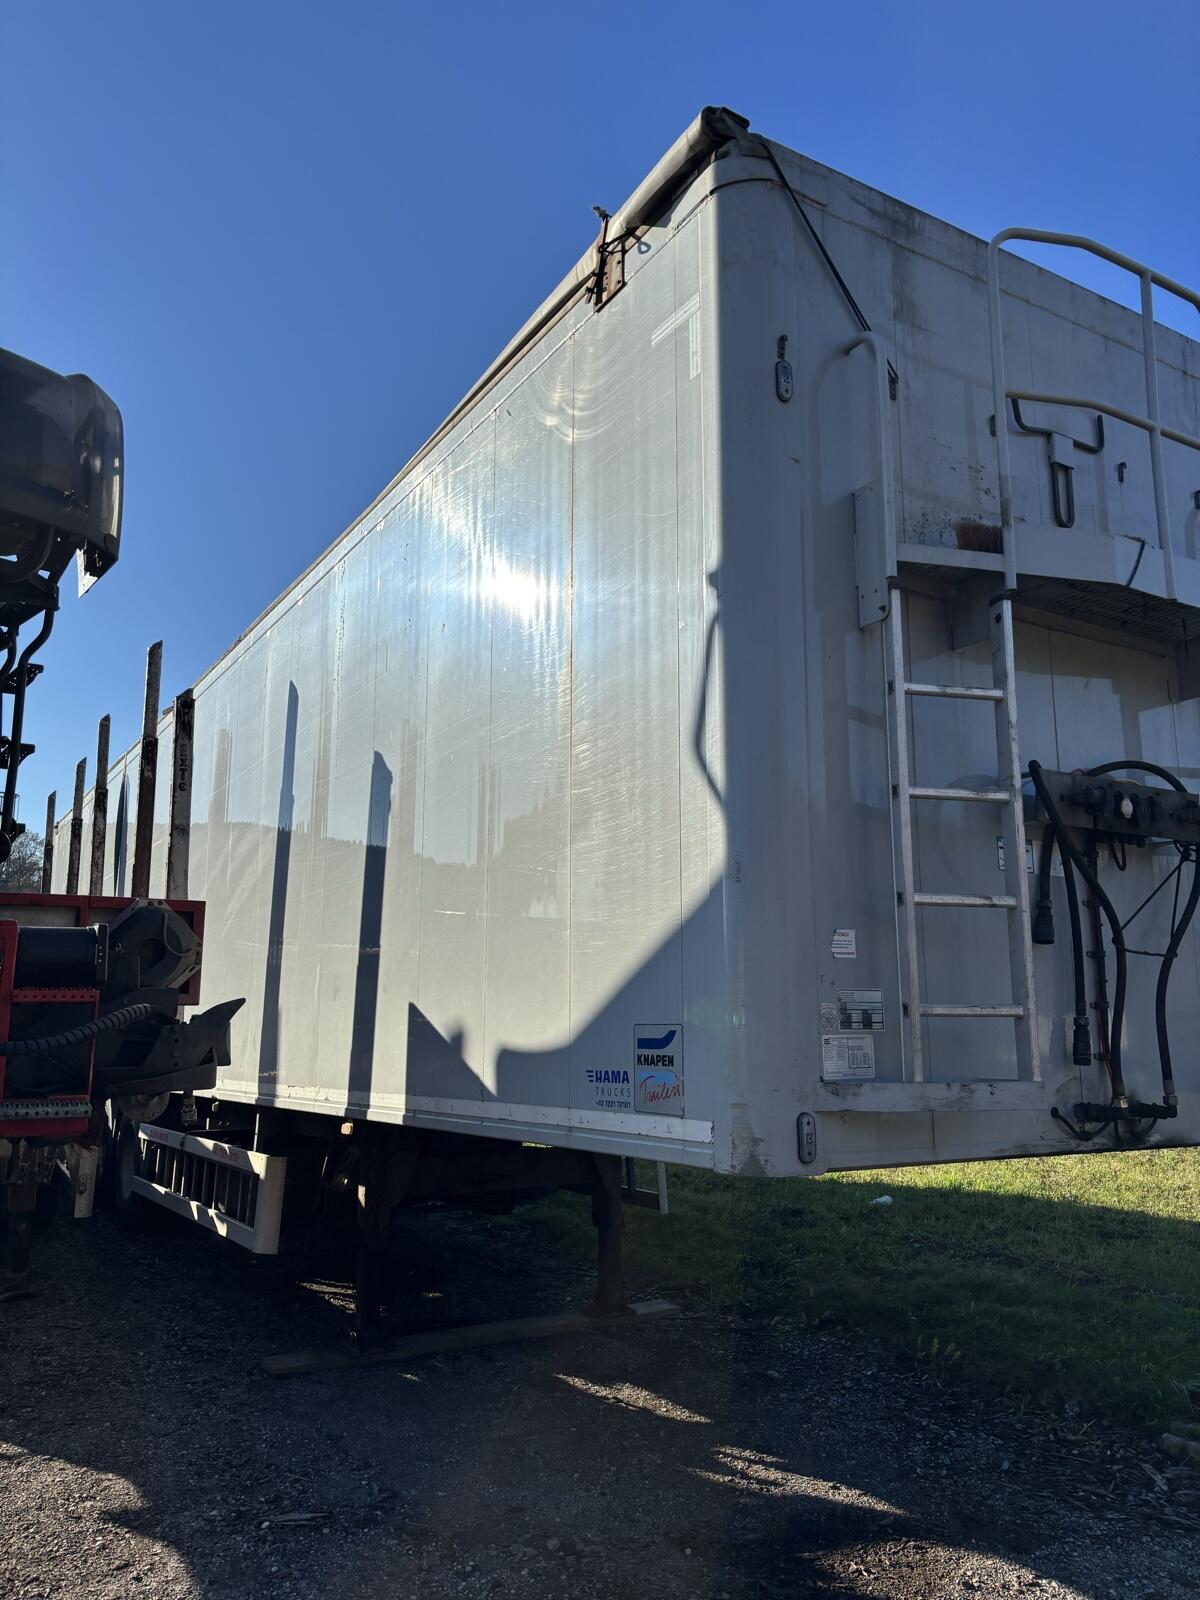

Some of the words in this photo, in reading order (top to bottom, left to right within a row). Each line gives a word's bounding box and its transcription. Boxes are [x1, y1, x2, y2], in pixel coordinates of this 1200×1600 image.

[637, 1053, 675, 1068] KNAPEN
[595, 1069, 630, 1084] HAMA
[595, 1086, 631, 1098] TRUCKS
[640, 1075, 681, 1105] Trailers
